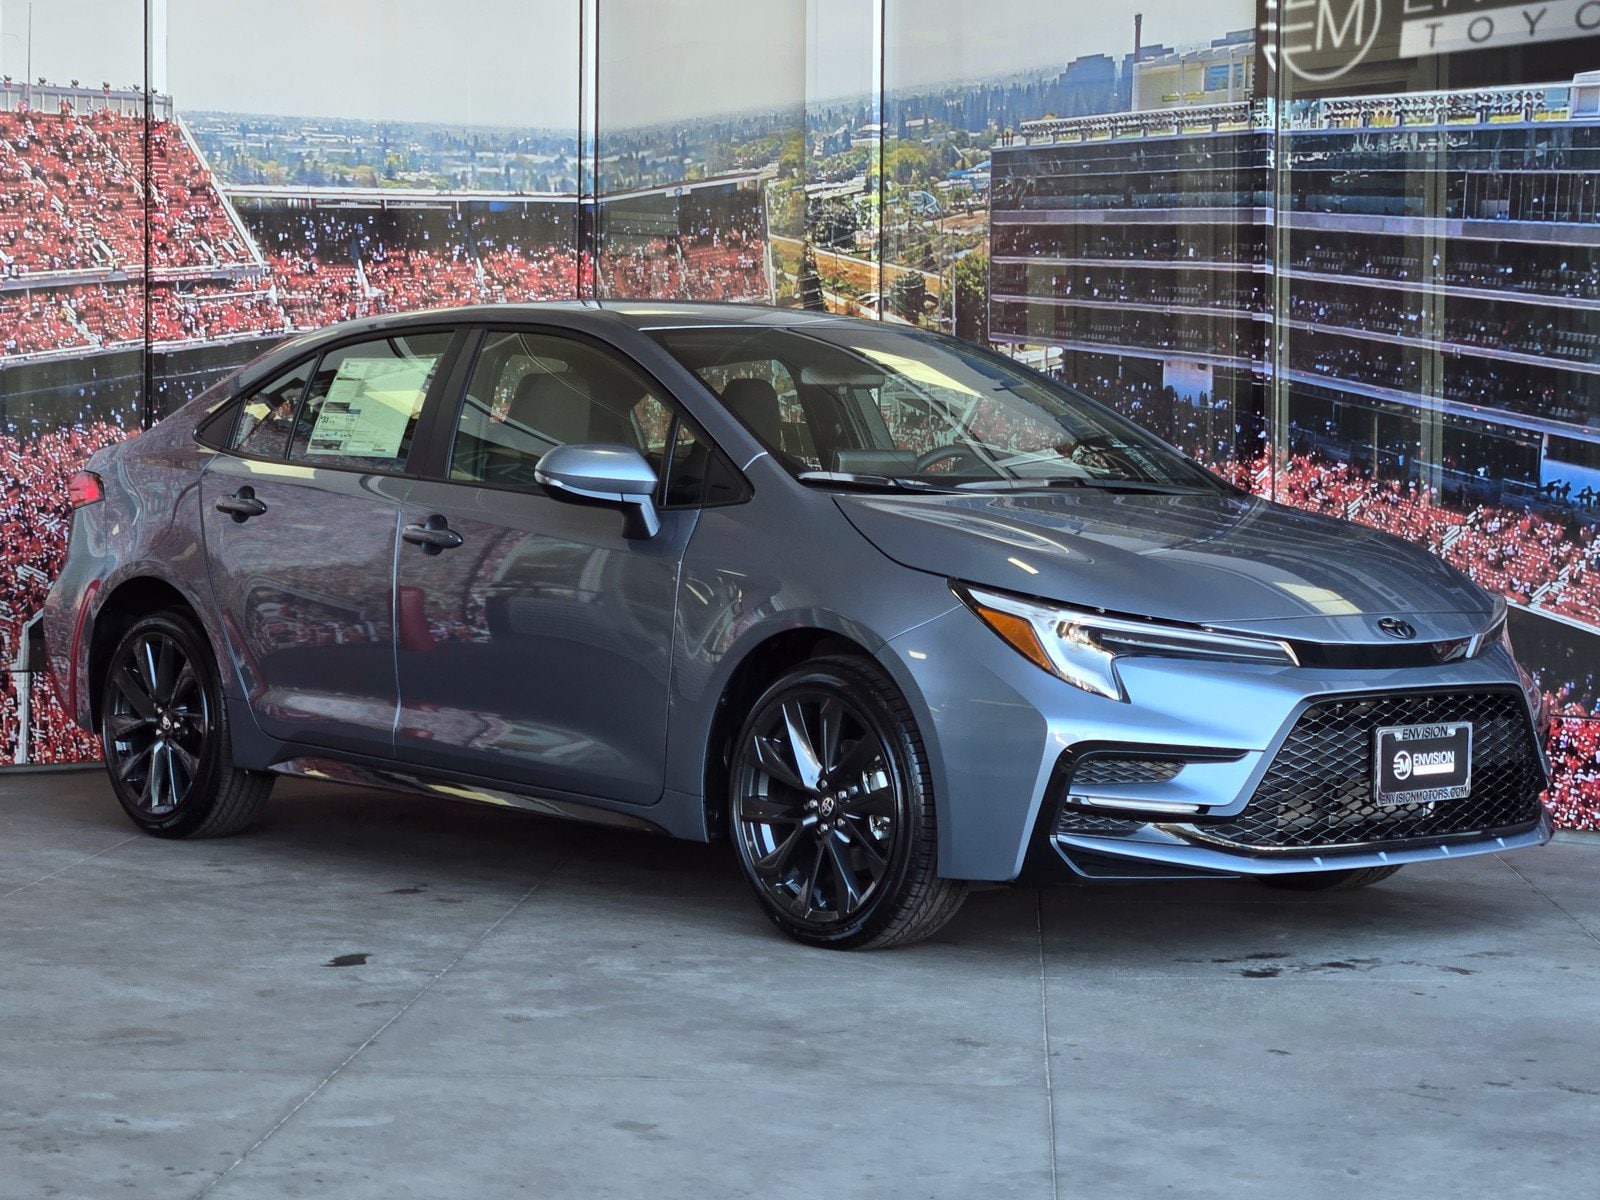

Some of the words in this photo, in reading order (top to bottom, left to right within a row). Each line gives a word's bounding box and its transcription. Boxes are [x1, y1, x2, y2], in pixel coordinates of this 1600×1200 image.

[1402, 726, 1448, 740] ENVISION
[1413, 750, 1455, 766] ENVISION
[1380, 787, 1468, 805] ENVISIONMOTORS.COM
